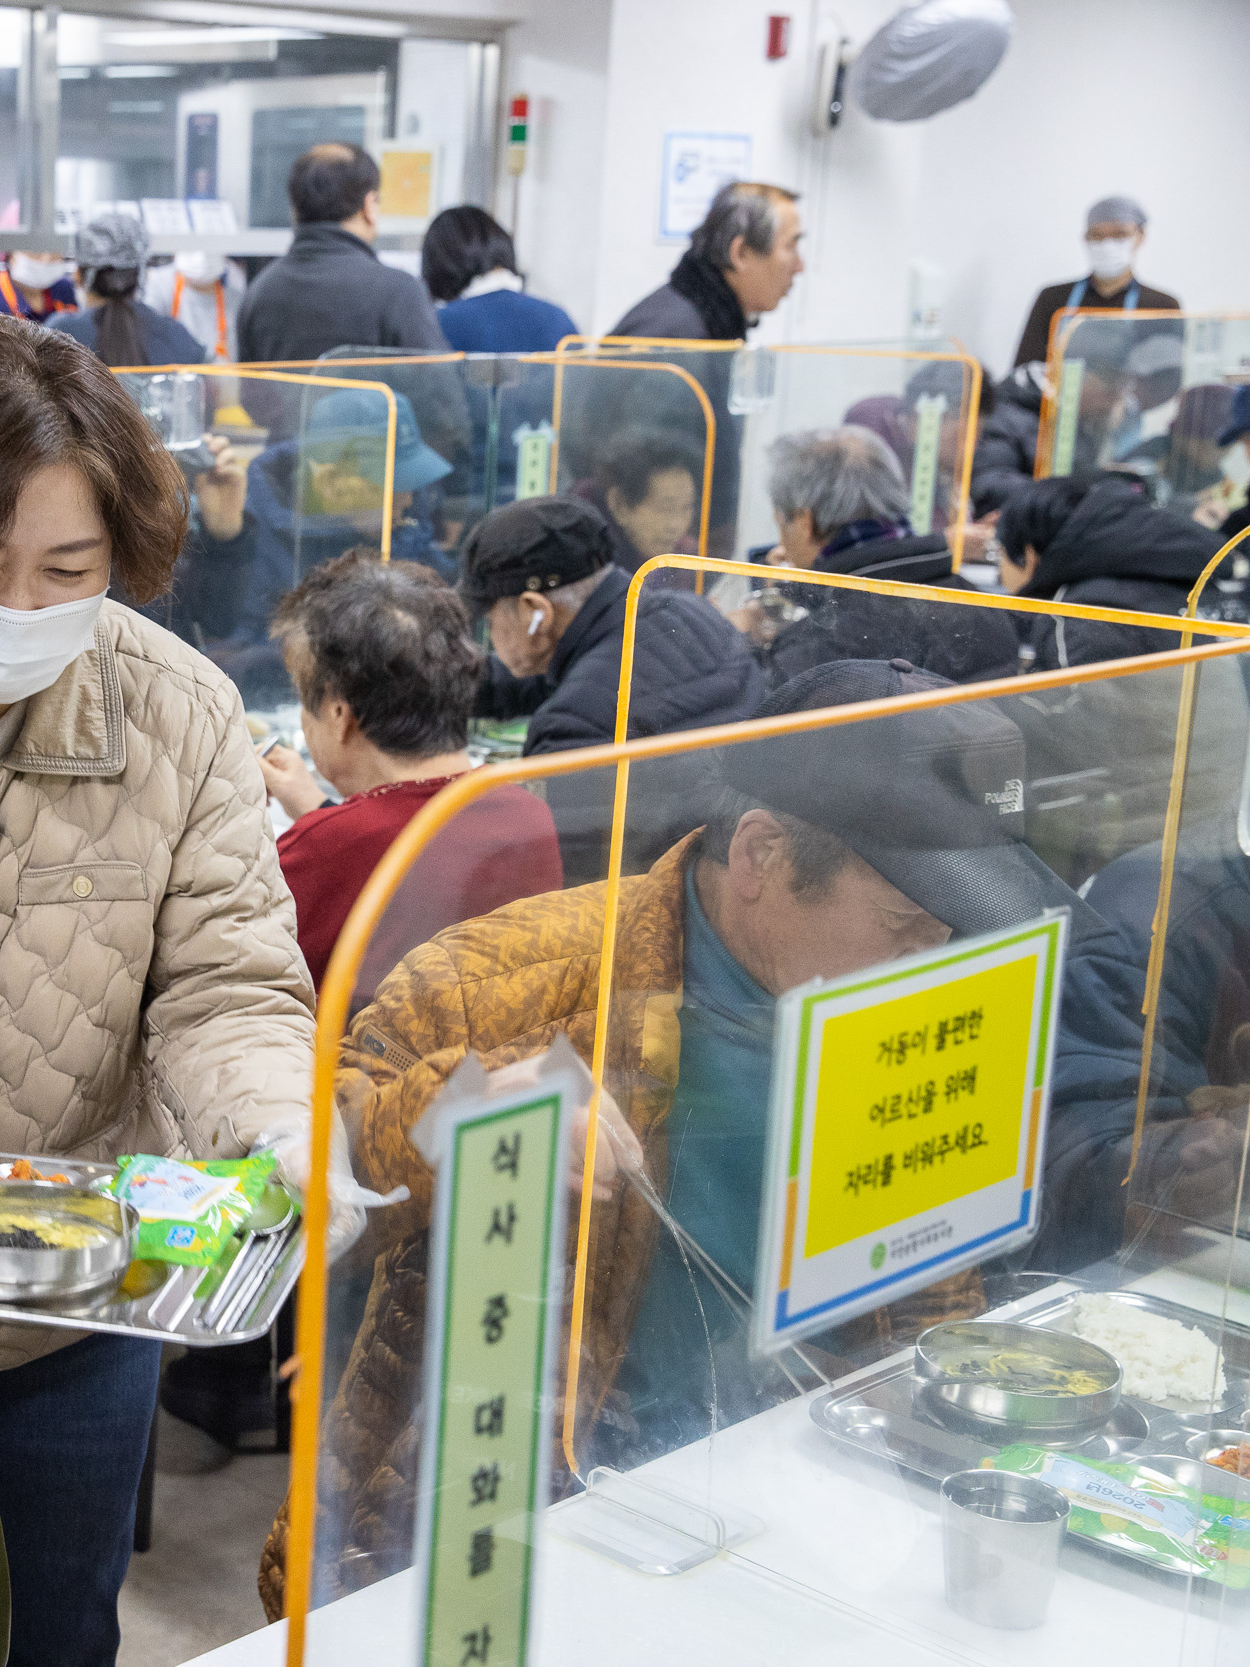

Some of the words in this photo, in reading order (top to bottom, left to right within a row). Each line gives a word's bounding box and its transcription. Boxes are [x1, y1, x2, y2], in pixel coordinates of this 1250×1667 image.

[875, 1024, 929, 1068] 거동이
[932, 1006, 985, 1053] 불편한
[868, 1078, 938, 1128] 어르신을
[942, 1063, 979, 1106] 위해
[843, 1152, 897, 1198] 자리를
[1085, 1482, 1146, 1510] 2026년
